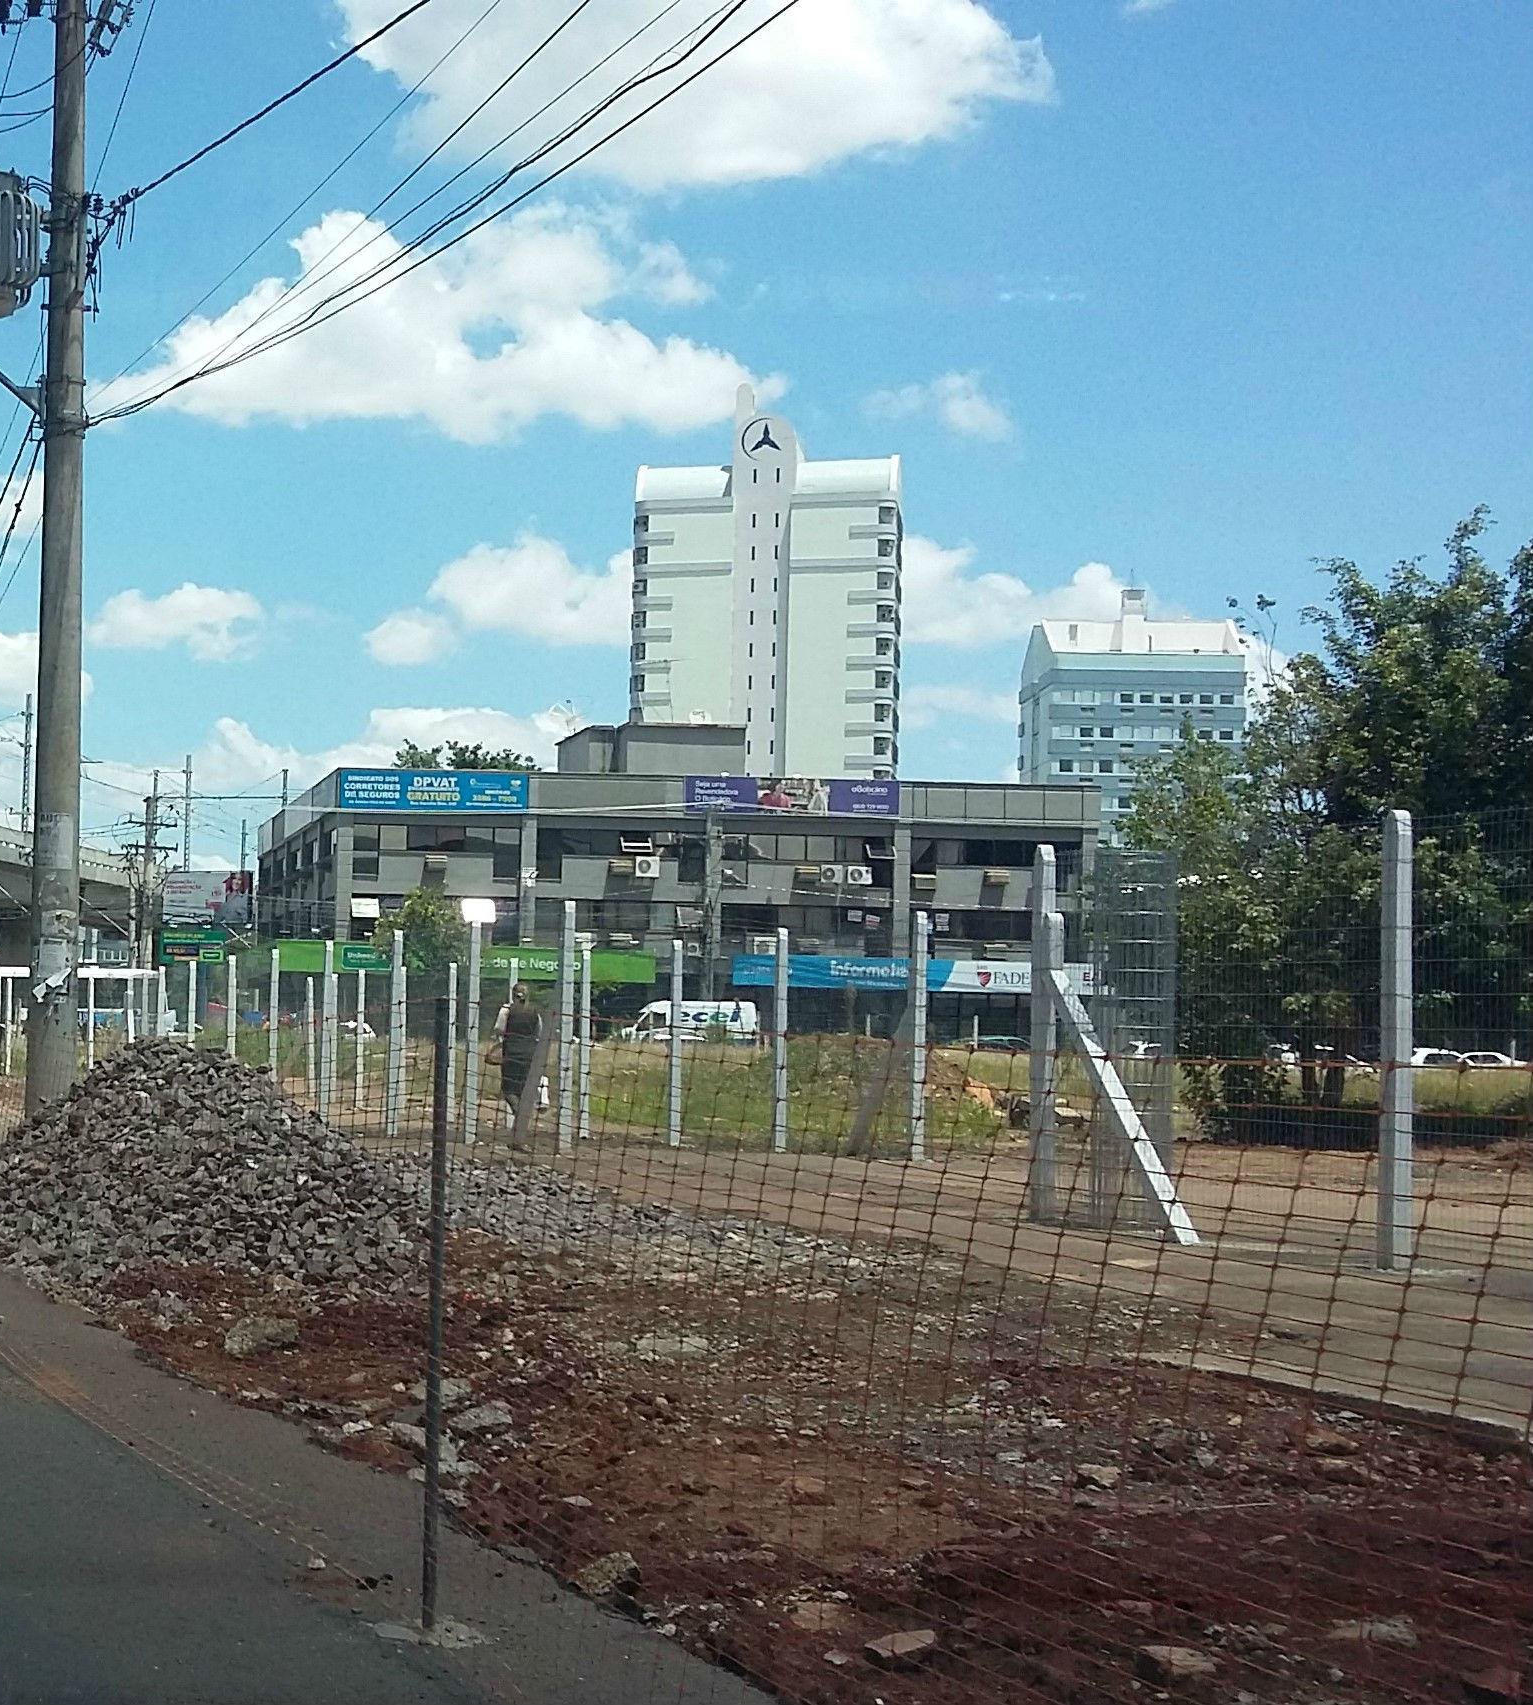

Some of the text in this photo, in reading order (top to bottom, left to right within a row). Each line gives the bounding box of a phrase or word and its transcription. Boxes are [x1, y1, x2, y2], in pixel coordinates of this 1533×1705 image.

[344, 782, 401, 791] CORRETORES
[413, 777, 458, 787] DPVAT
[695, 780, 710, 789] Seja
[345, 790, 400, 799] DE SEGUROS
[407, 791, 461, 801] GRATUITO
[695, 788, 739, 796] Revendedora
